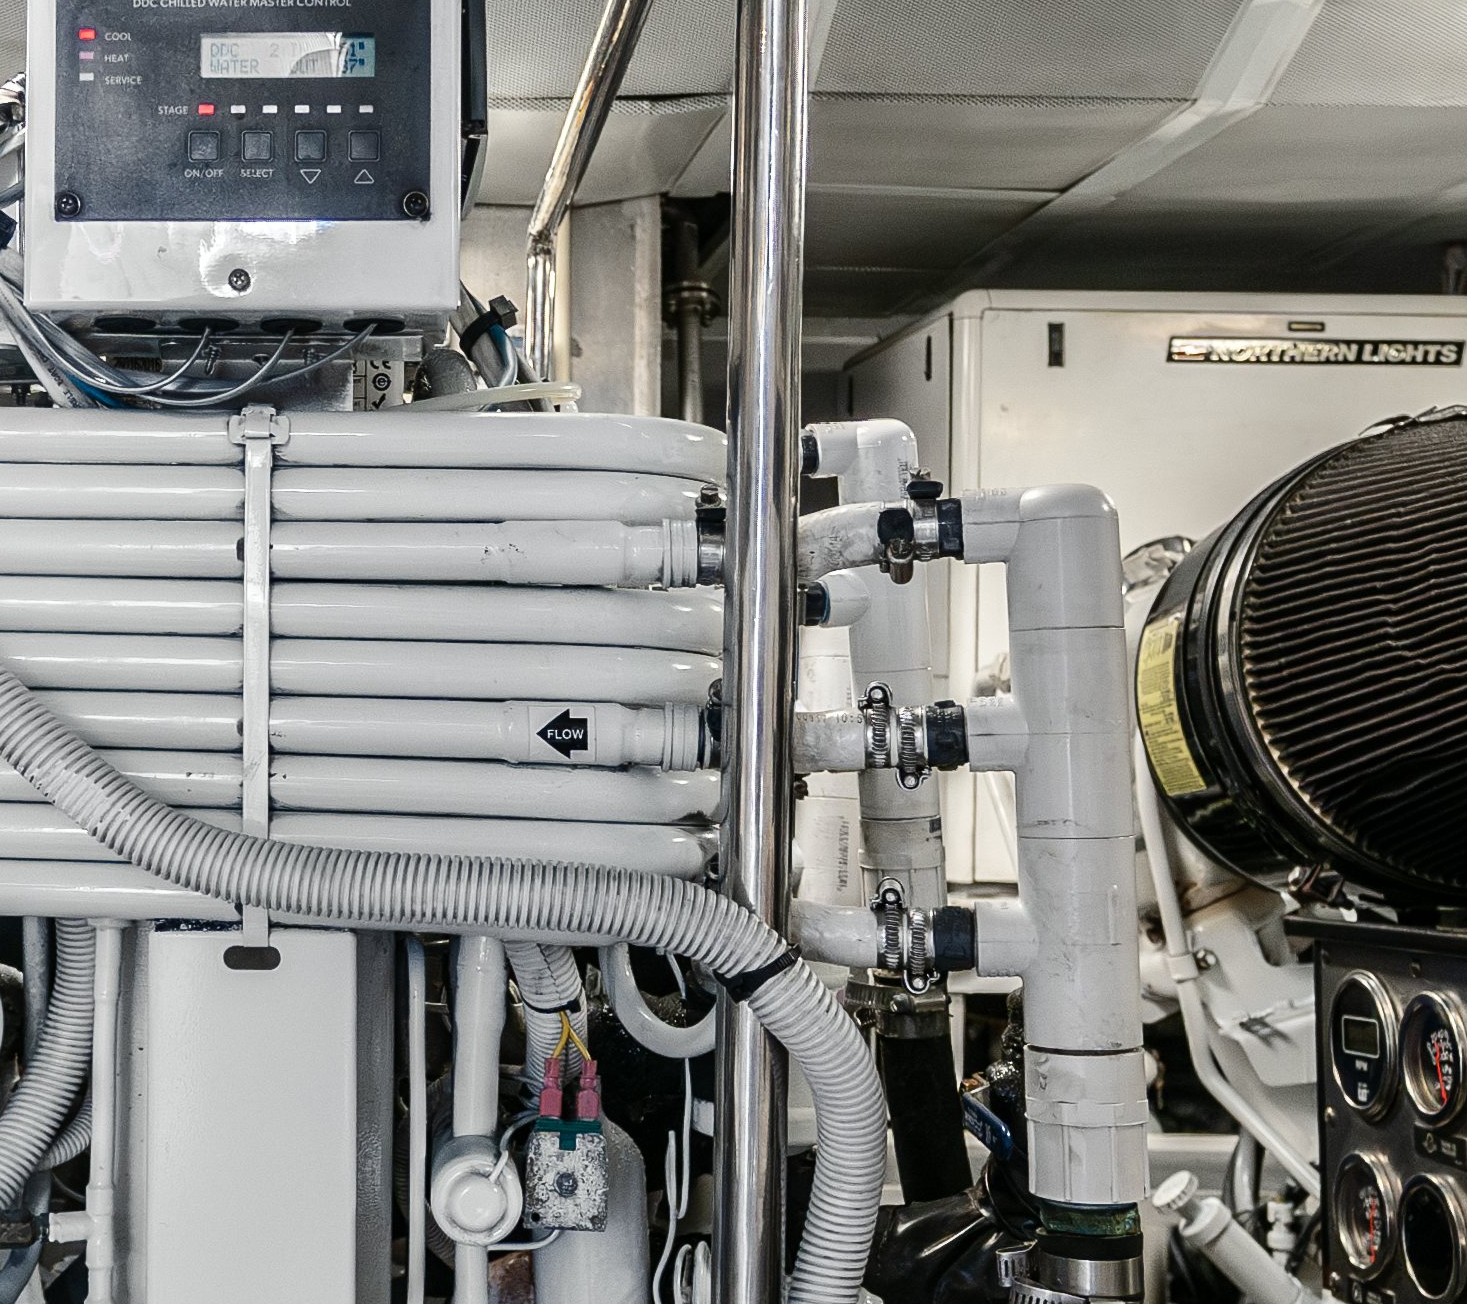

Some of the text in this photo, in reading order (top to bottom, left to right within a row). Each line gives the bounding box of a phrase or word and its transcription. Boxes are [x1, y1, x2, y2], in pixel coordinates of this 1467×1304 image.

[105, 32, 132, 41] COOL
[210, 43, 239, 58] DDC
[270, 45, 280, 58] 2
[104, 54, 129, 63] HEAT
[210, 59, 260, 74] WATER
[105, 75, 142, 85] SERVICE
[157, 105, 189, 115] STAGE
[184, 168, 274, 179] ON/OFF SELECT
[1210, 341, 1459, 363] NORTHERN LIGHTS
[547, 729, 584, 740] FLOW
